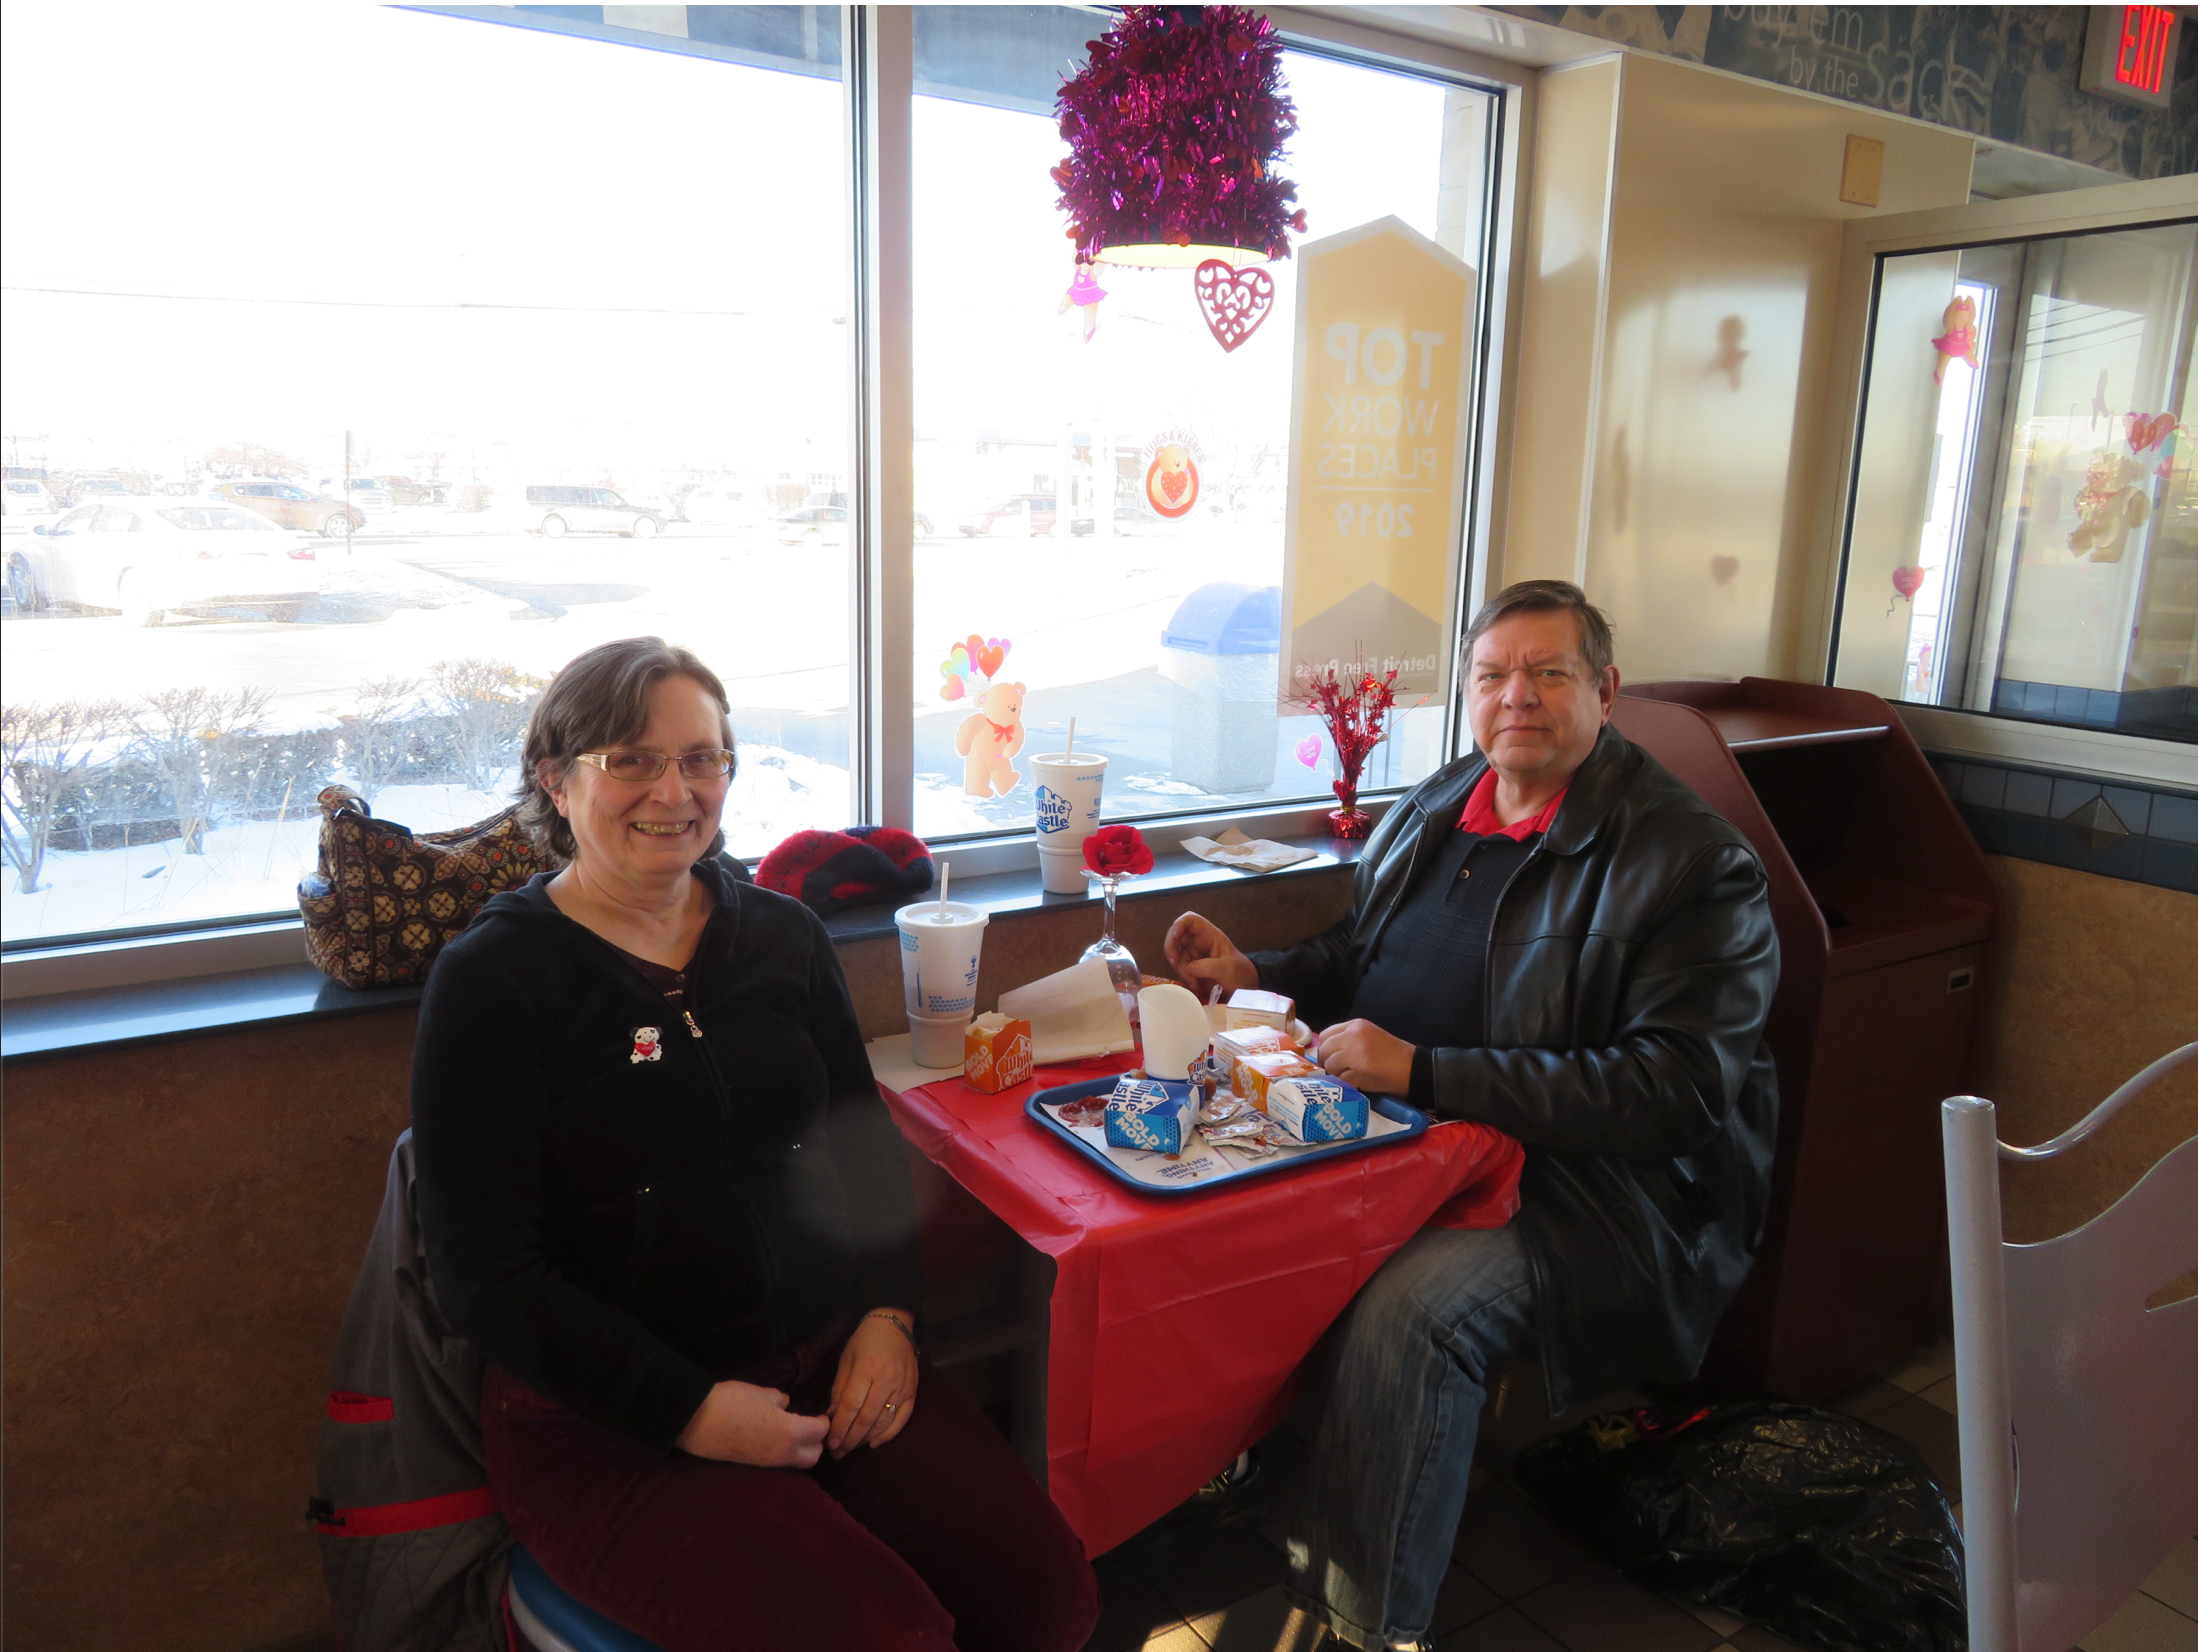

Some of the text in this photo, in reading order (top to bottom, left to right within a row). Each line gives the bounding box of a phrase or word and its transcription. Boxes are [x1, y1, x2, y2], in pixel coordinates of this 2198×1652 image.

[2116, 5, 2175, 93] EXIT
[1789, 45, 1817, 90] by
[1824, 56, 1860, 99] the
[1143, 430, 1206, 462] HUGS & KISSES
[1038, 814, 1070, 827] astle
[966, 1045, 989, 1071] BOLD
[1109, 1081, 1132, 1111] astle
[1123, 1111, 1160, 1146] BOLD
[1323, 1102, 1352, 1134] BOLD
